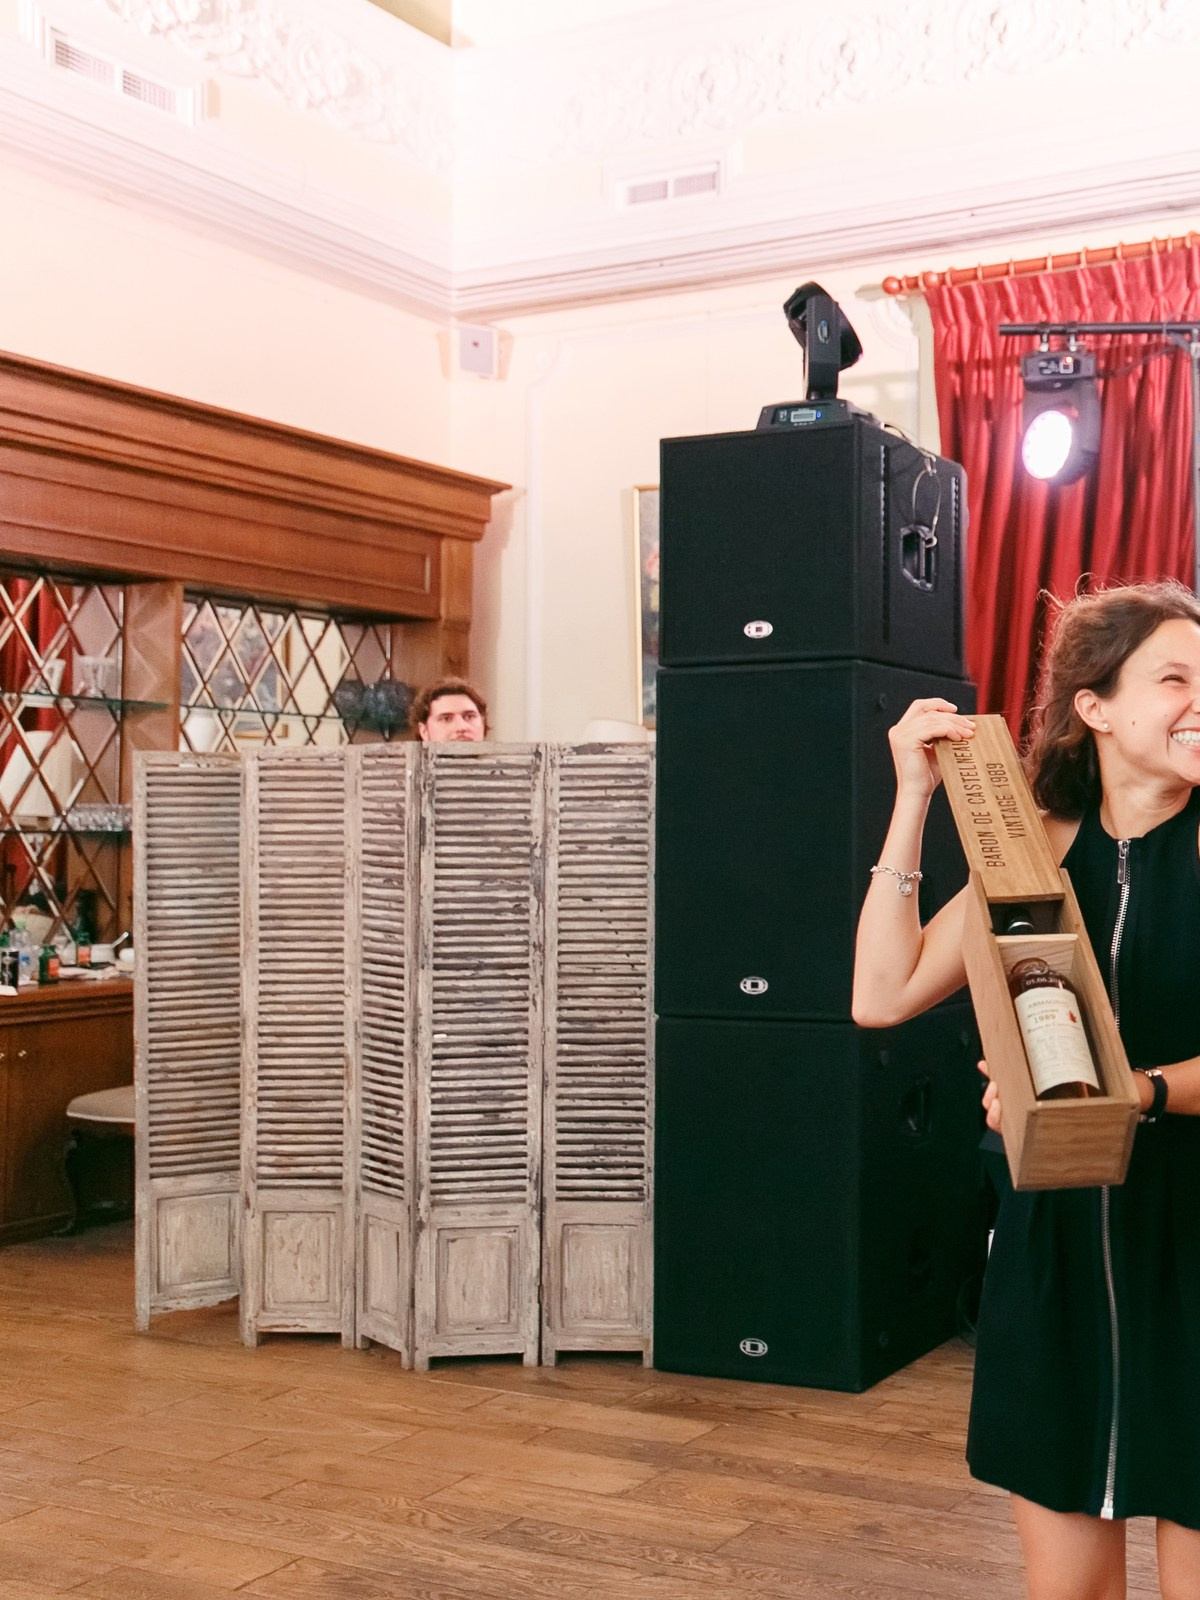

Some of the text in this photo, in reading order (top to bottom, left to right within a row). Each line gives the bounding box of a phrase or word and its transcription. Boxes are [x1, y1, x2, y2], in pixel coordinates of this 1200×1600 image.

[951, 738, 1006, 868] BARON DE CASTELNEAU
[986, 762, 1026, 839] VINTAGE 1989
